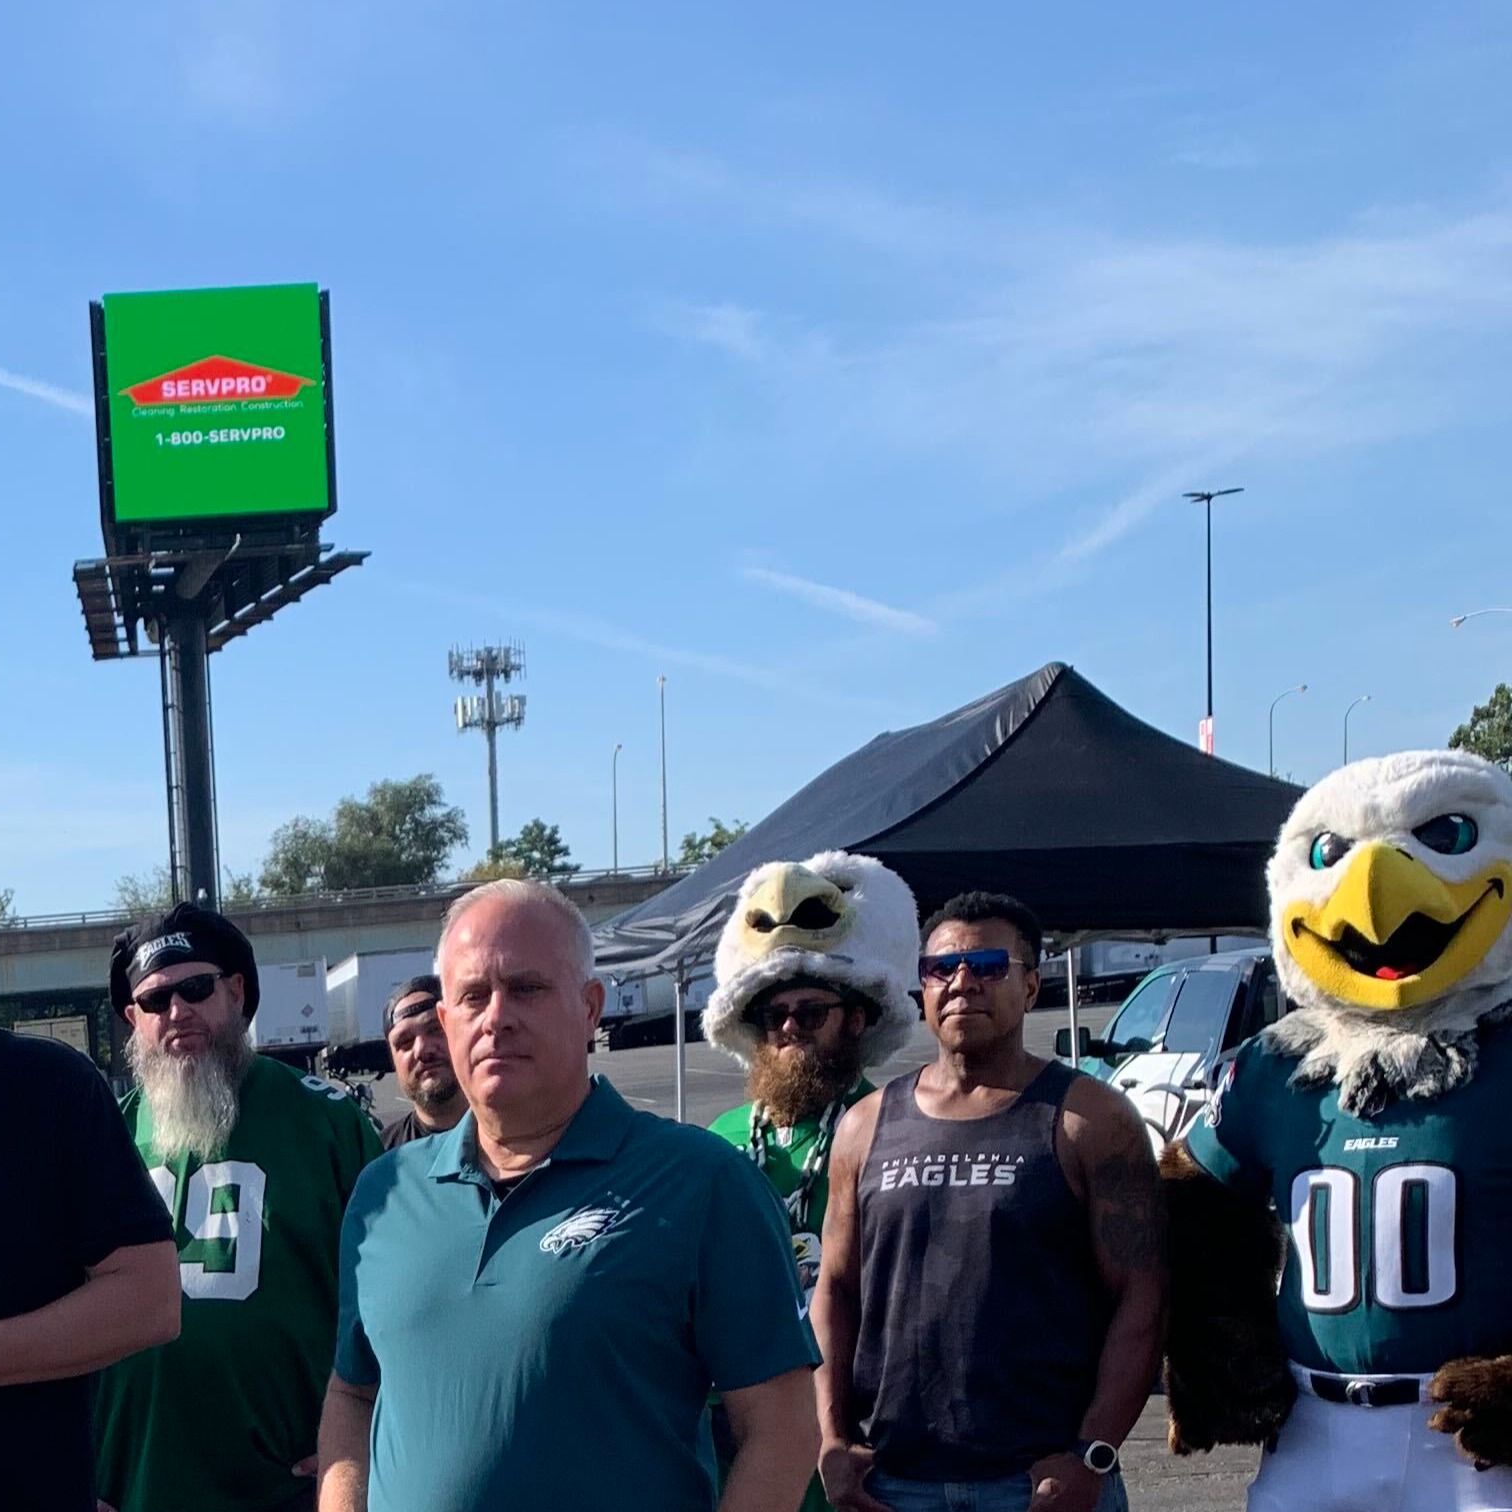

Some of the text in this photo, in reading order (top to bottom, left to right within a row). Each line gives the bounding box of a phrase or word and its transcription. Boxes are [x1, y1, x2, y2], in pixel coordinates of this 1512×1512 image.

[161, 375, 267, 399] SERVPRO
[131, 399, 304, 418] Cleaning Restoration Construction
[155, 426, 286, 446] 1-800-SERVPRO
[136, 932, 192, 972] EAGLES
[1343, 1136, 1400, 1151] EAGLES
[881, 1153, 1025, 1170] PHILADELPHIA
[879, 1164, 1017, 1192] EAGLES
[148, 1160, 267, 1301] 9
[1290, 1163, 1459, 1311] 00
